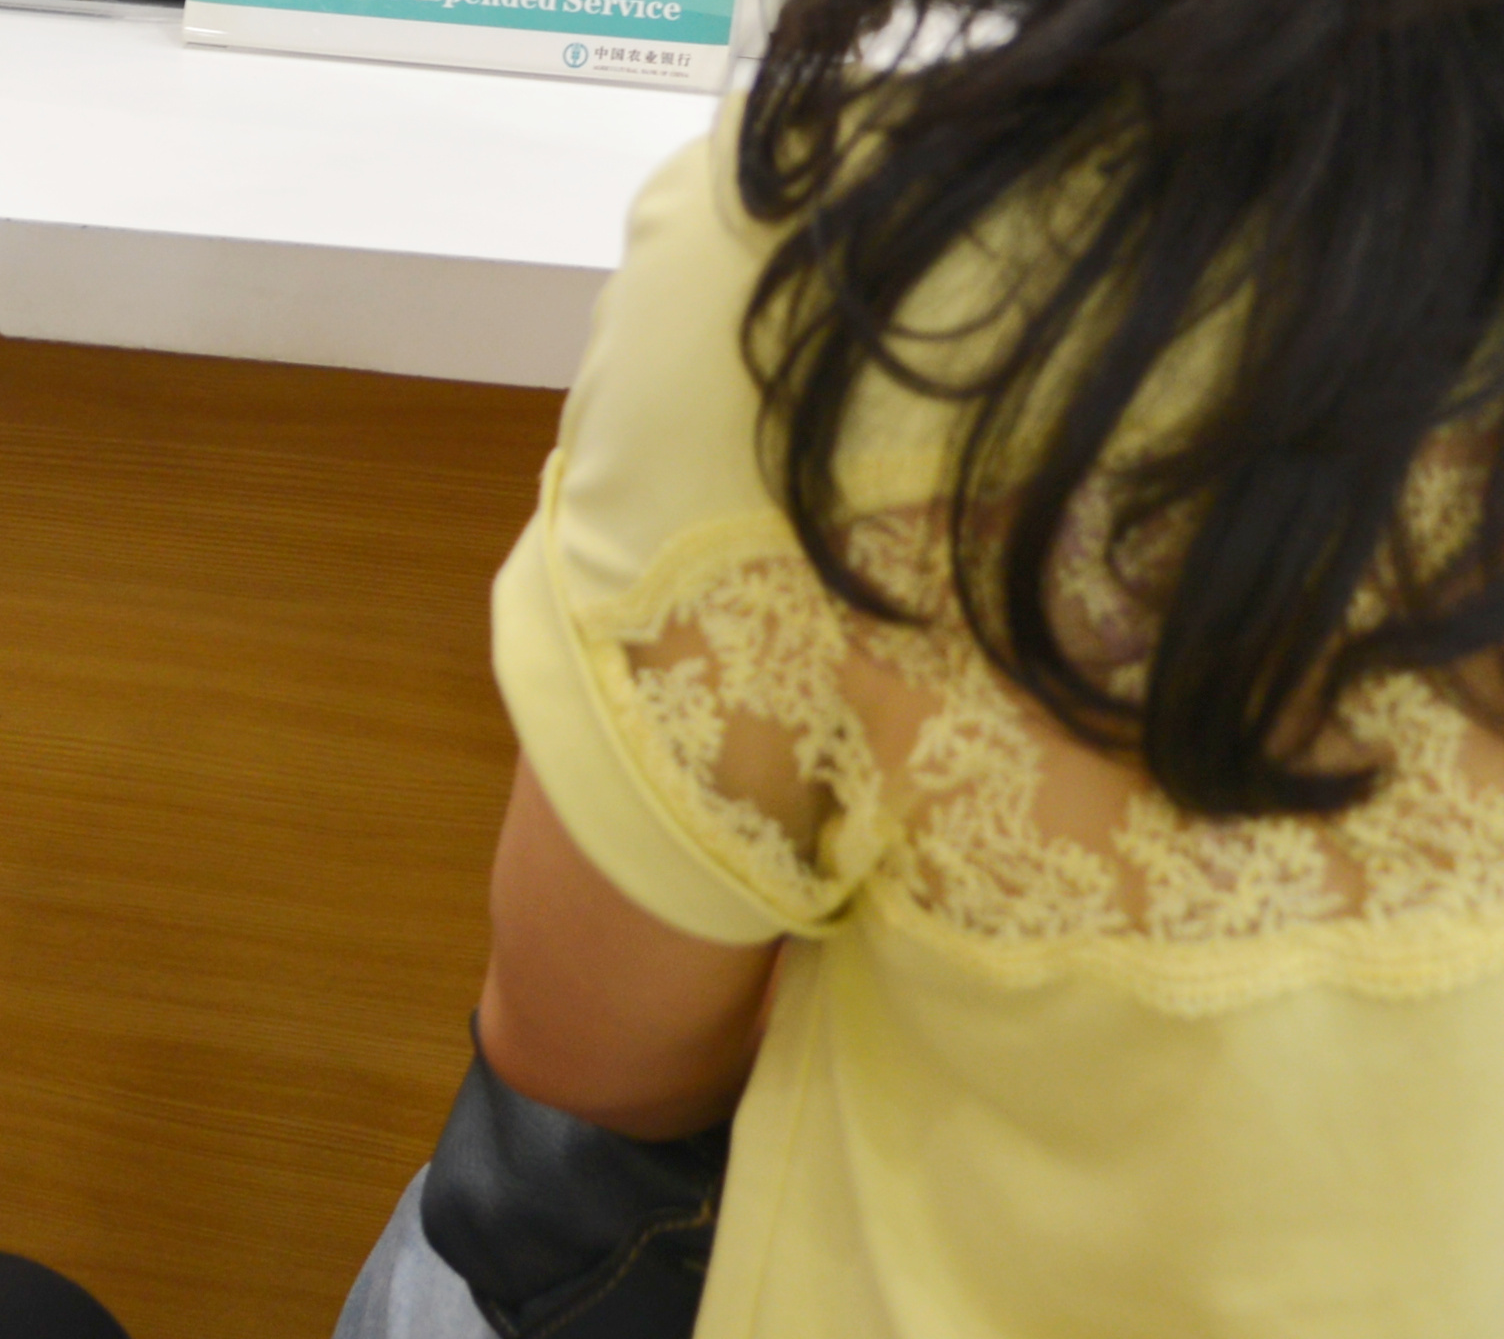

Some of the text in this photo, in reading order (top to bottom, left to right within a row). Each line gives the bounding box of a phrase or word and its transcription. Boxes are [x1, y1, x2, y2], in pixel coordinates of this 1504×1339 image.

[594, 46, 692, 67] 中国农业银行
